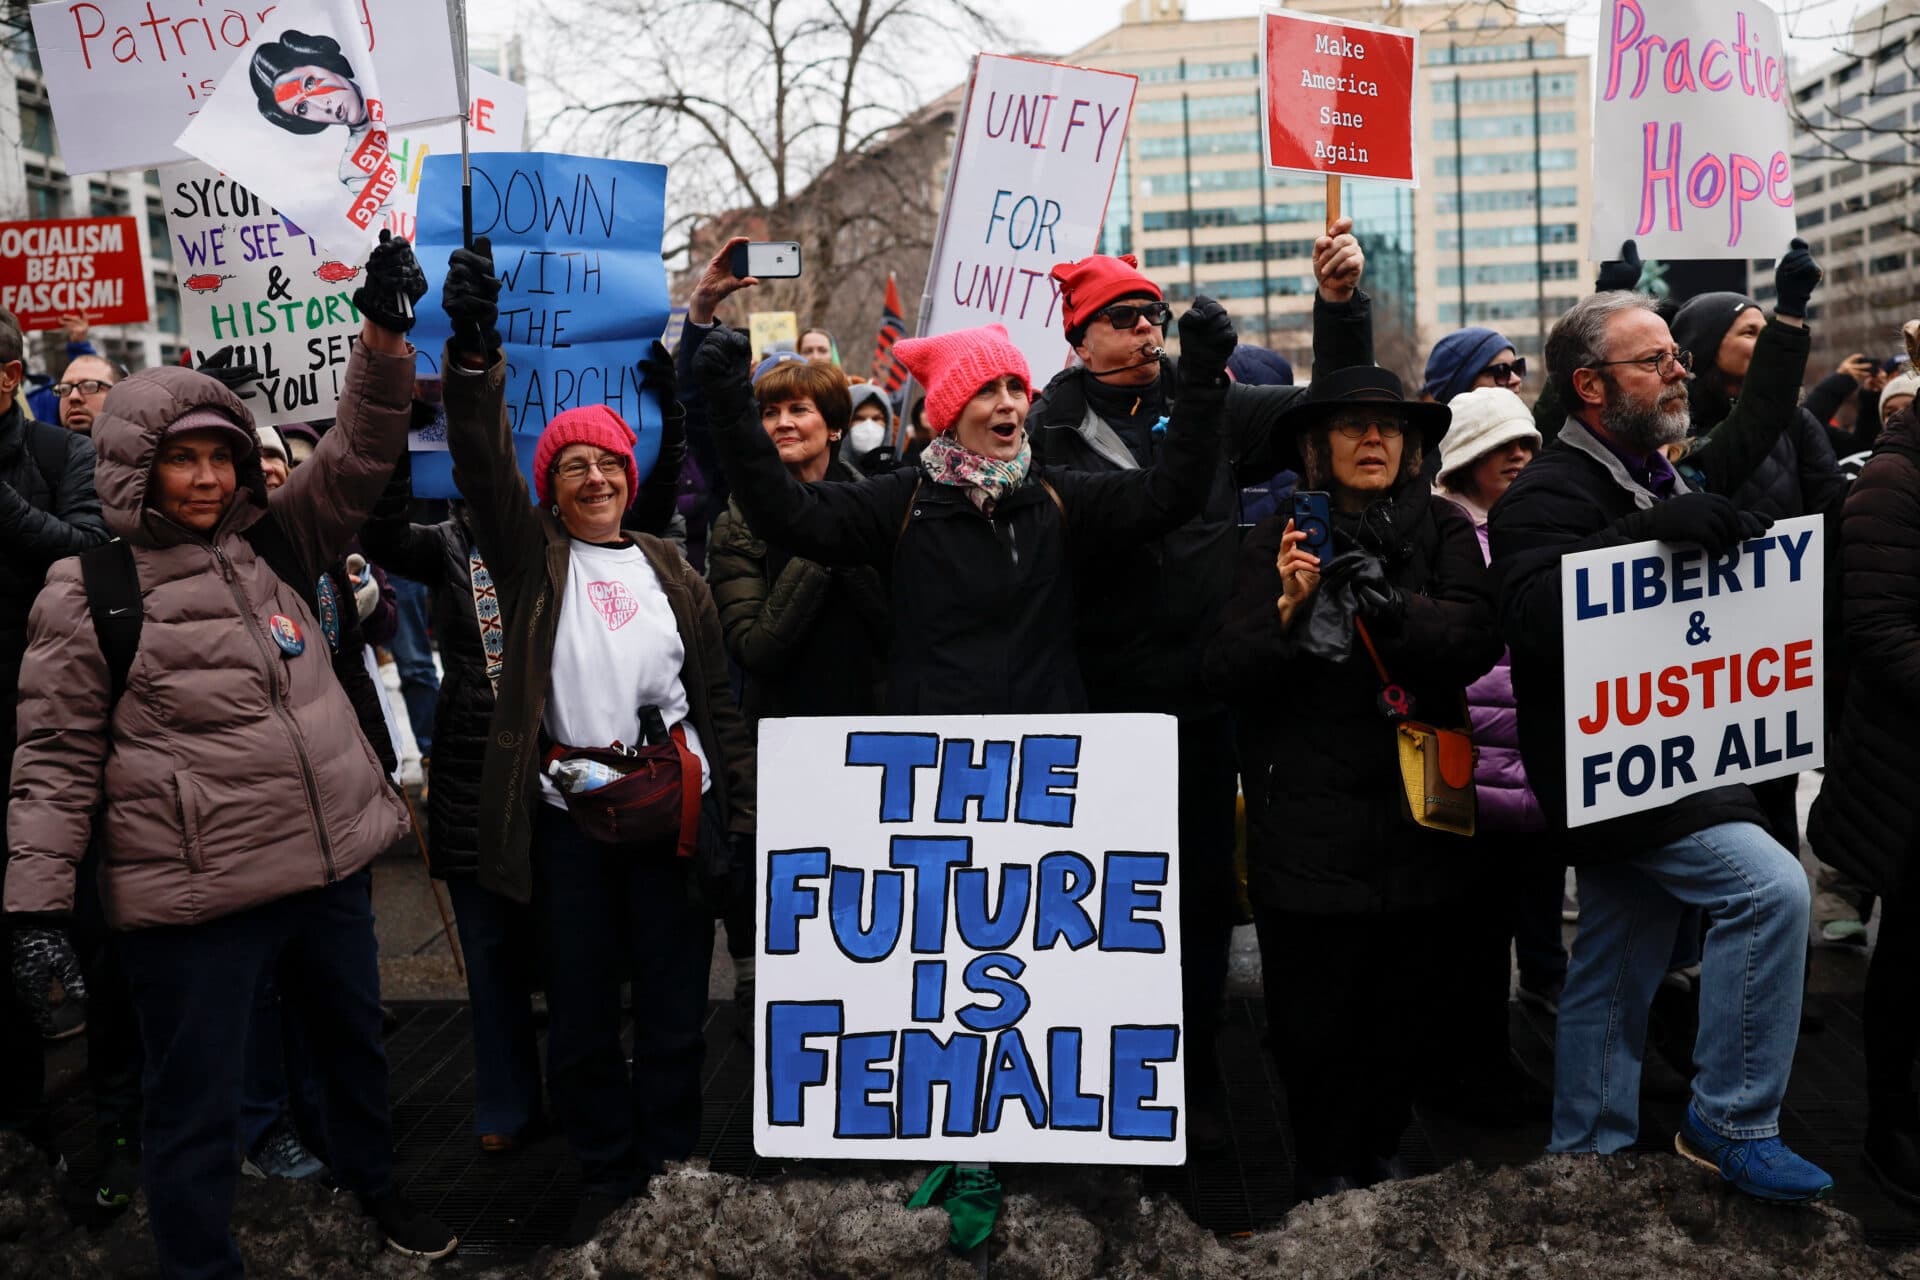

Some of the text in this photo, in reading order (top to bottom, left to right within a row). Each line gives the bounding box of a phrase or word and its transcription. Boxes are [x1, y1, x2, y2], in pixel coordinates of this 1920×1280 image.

[1315, 33, 1365, 60] Make
[1301, 69, 1378, 97] America
[986, 91, 1120, 163] UNIFY
[1320, 106, 1364, 129] Sane
[1314, 140, 1369, 164] Again
[469, 166, 616, 238] DOWN
[1636, 121, 1795, 247] Hope
[0, 223, 124, 258] OCIALISM
[178, 228, 226, 267] WE
[240, 223, 284, 262] SEE
[985, 189, 1062, 254] FOR
[26, 254, 96, 283] BEATS
[267, 265, 293, 301] &
[500, 249, 601, 294] WITH
[2, 277, 123, 314] FASCISM!
[211, 291, 361, 339] HISTORY
[954, 261, 1063, 328] UNITY
[500, 308, 572, 348] THE
[1576, 530, 1813, 621] LIBERTY
[1686, 611, 1711, 646] &
[1578, 639, 1813, 735] JUSTICE
[845, 731, 1082, 828] THE
[1583, 710, 1813, 807] FOR ALL
[765, 835, 1169, 963] FUTURE
[911, 952, 1031, 1032] IS
[766, 1000, 1180, 1141] FEMALE
